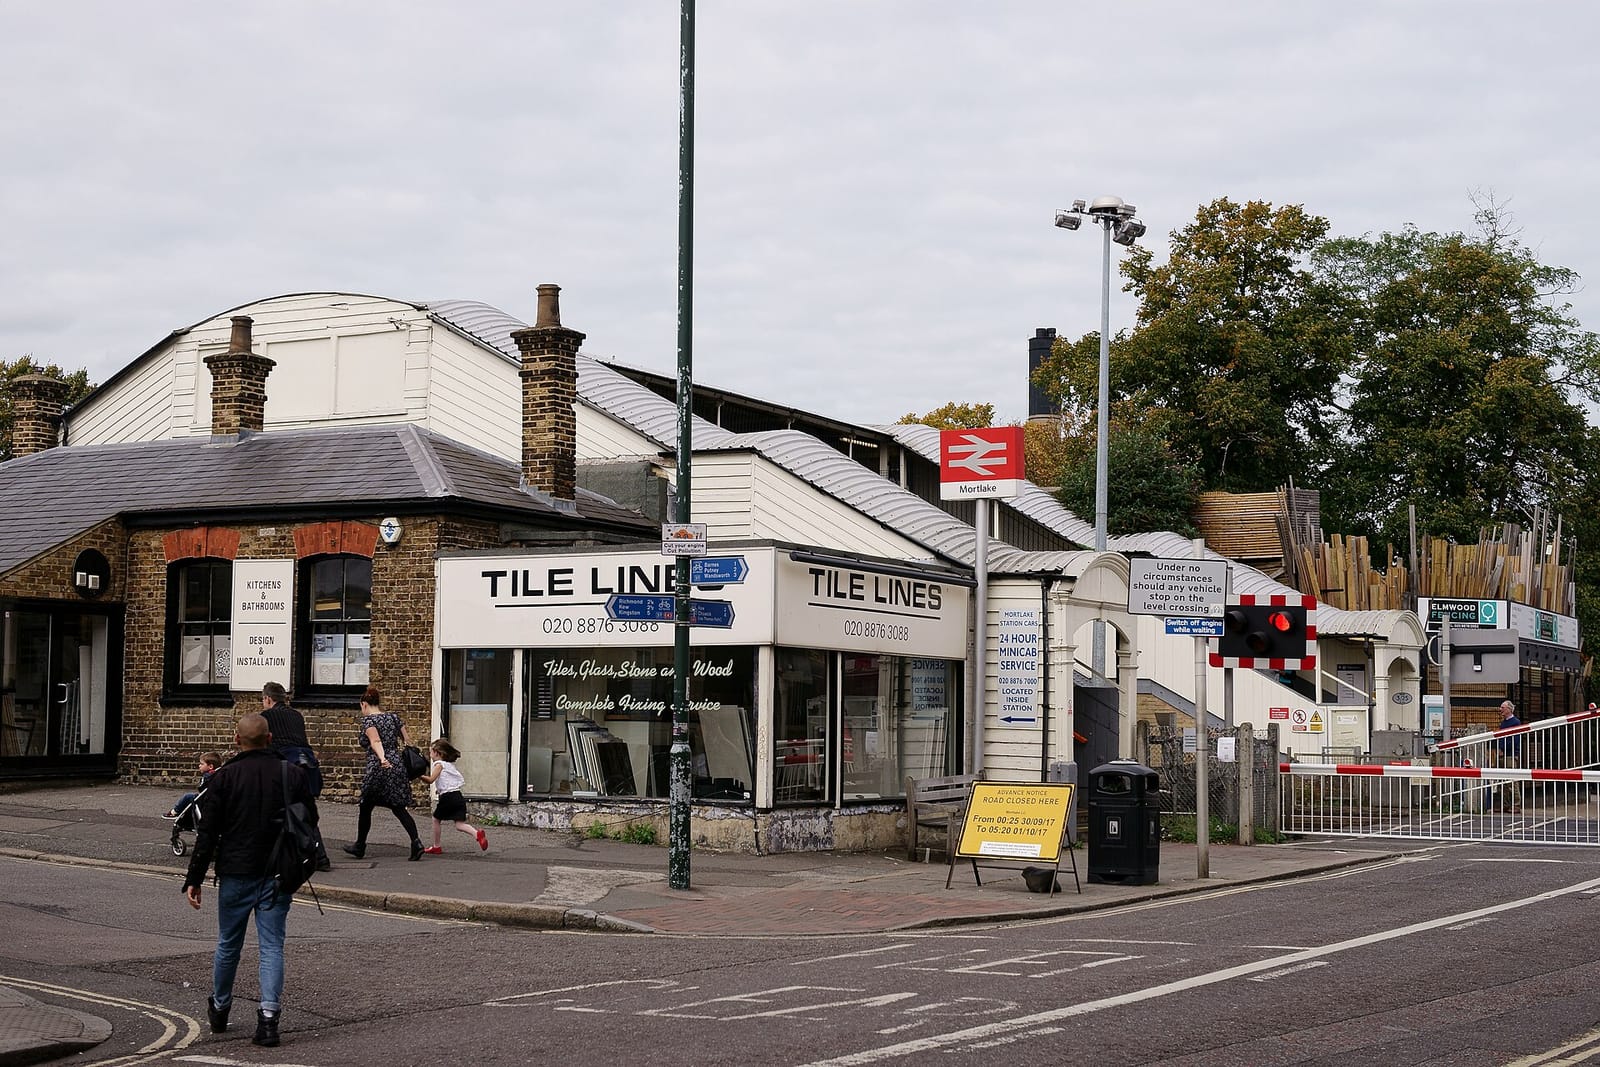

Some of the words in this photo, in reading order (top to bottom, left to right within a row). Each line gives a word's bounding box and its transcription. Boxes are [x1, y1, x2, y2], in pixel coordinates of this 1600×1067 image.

[960, 484, 996, 494] Mortlake
[1156, 562, 1185, 572] Under
[482, 568, 573, 597] TILE
[1144, 573, 1212, 583] circumstances
[246, 580, 282, 590] KITCHENS
[809, 568, 864, 600] TILE
[874, 576, 942, 610] LINES
[1133, 582, 1165, 590] should
[1168, 584, 1185, 592] any
[1188, 584, 1222, 593] vehicle
[261, 591, 266, 600] &
[1150, 594, 1170, 602] stop
[1188, 594, 1204, 602] the
[242, 601, 284, 612] BATHROOMS
[1144, 602, 1166, 610] level
[1169, 604, 1210, 614] crossing
[543, 618, 572, 634] 020
[577, 618, 614, 634] 8876
[618, 621, 658, 634] 3088
[1202, 620, 1222, 628] engine
[844, 620, 862, 636] 020
[864, 622, 886, 639] 8876
[888, 624, 908, 641] 3088
[249, 636, 274, 646] DESIGN
[1000, 634, 1009, 644] 24
[1012, 634, 1037, 644] HOUR
[258, 646, 264, 655] &
[999, 648, 1037, 657] MINICAB
[236, 656, 286, 667] INSTALLATION
[1000, 660, 1036, 670] SERVICE
[693, 660, 734, 676] Wood
[556, 694, 614, 714] Complete
[619, 695, 666, 716] Fixing
[973, 815, 994, 823] From
[997, 816, 1019, 824] 00:25
[1020, 818, 1055, 826] 30/09/17
[976, 825, 986, 833] To
[989, 826, 1010, 834] 05:20
[1013, 828, 1048, 836] 01/10/17
